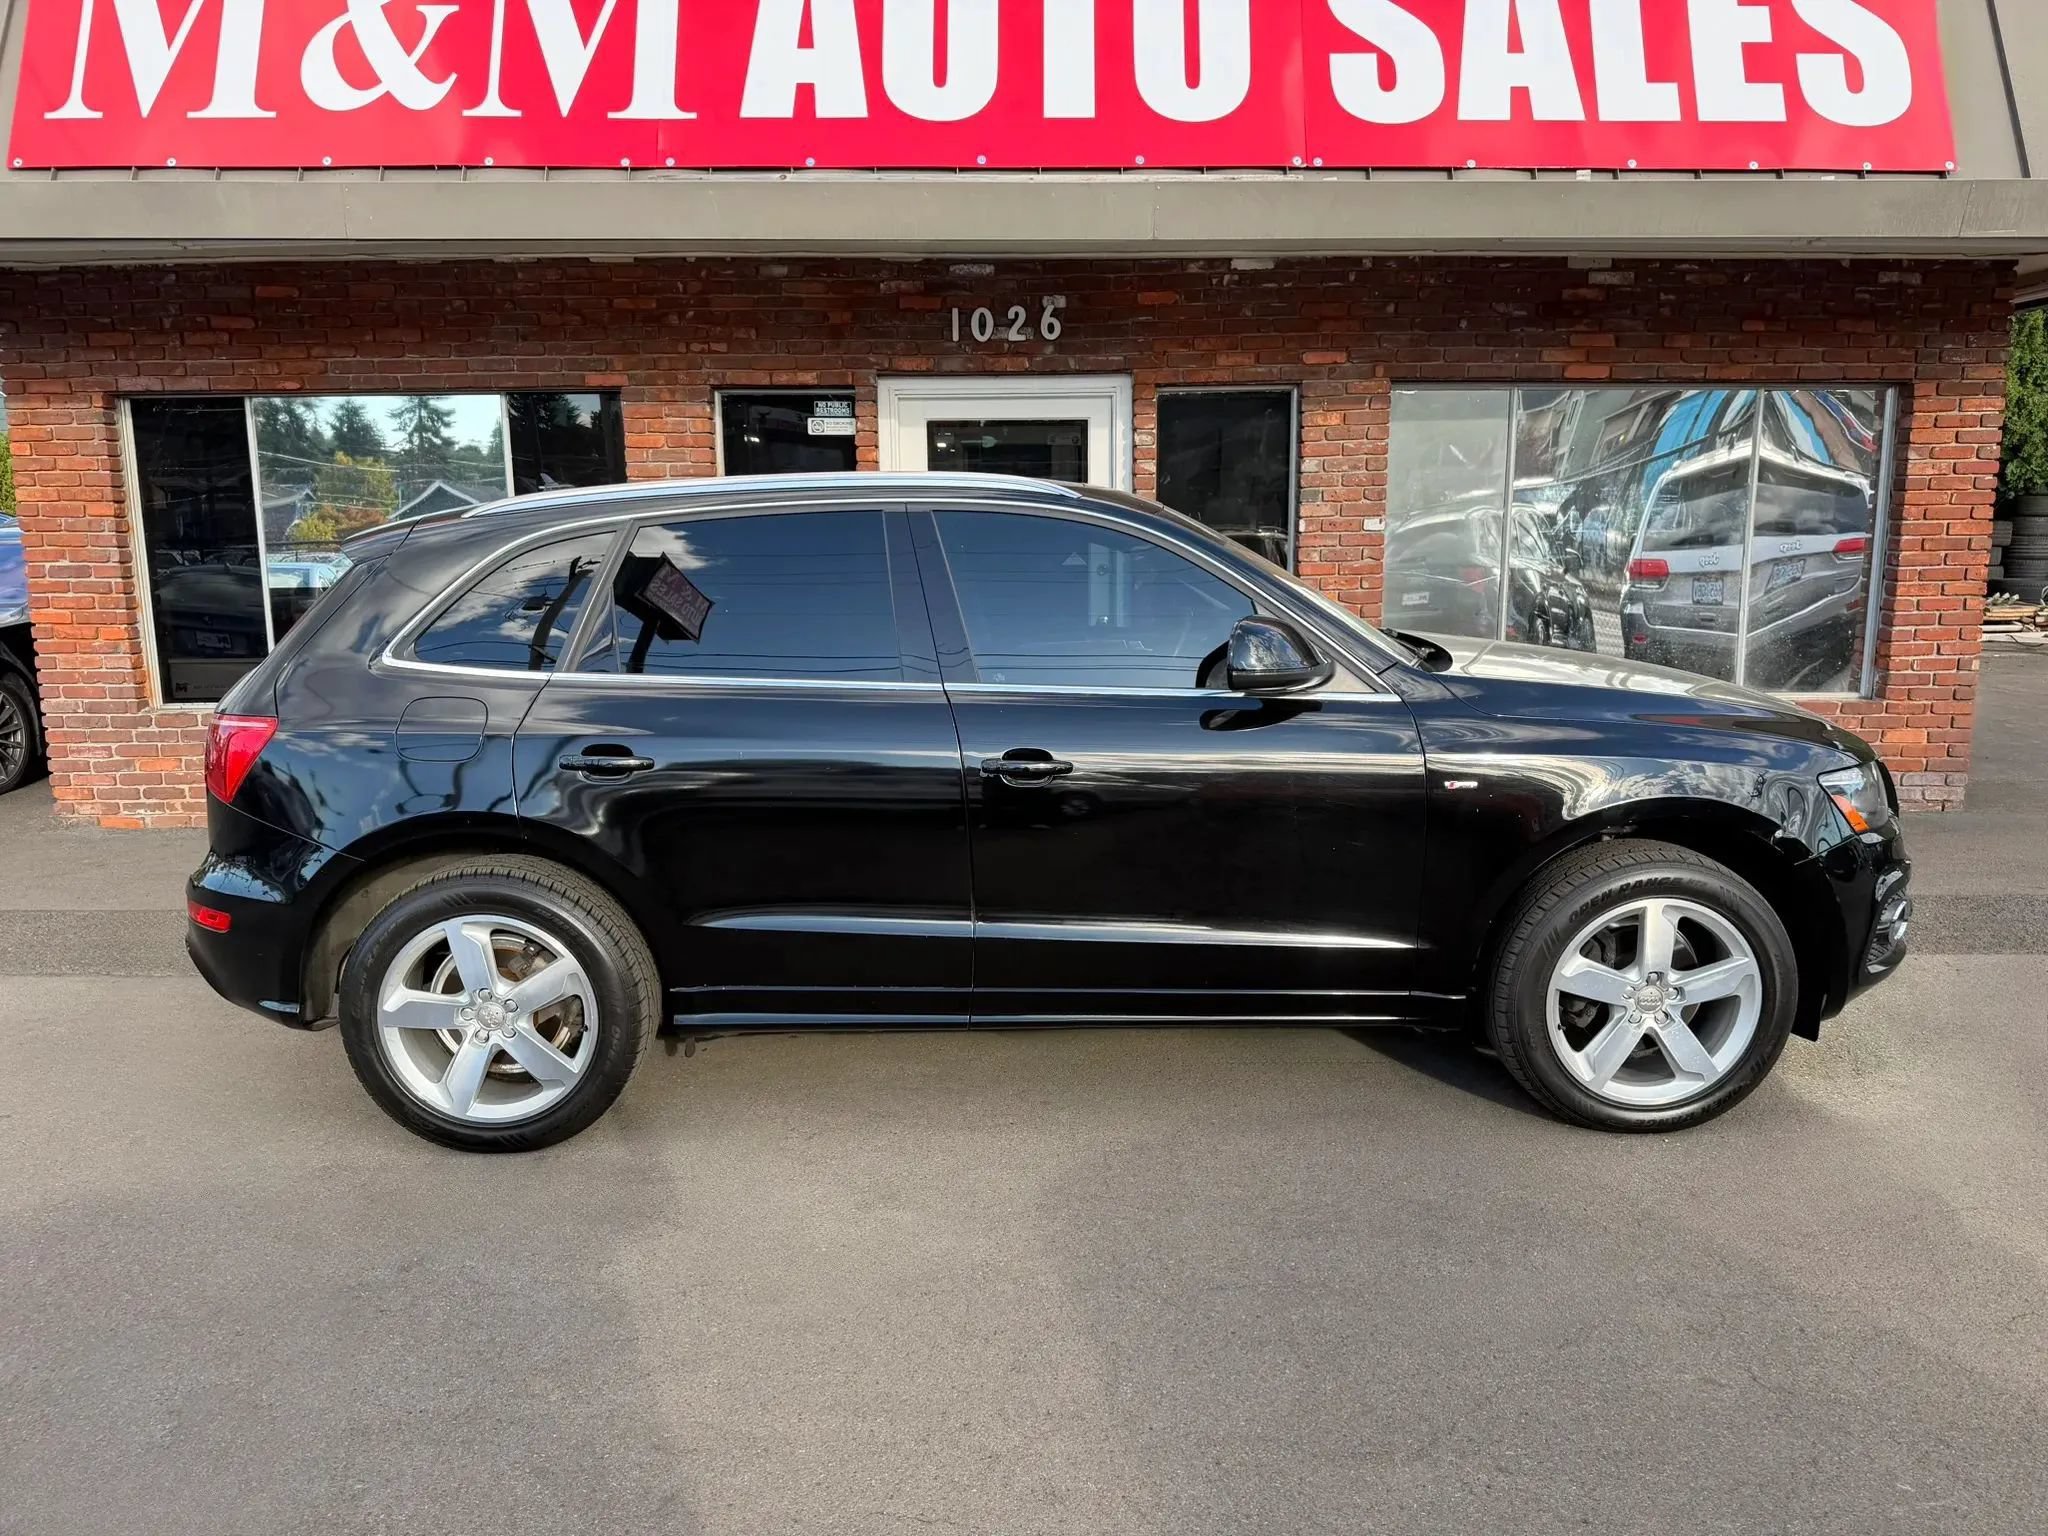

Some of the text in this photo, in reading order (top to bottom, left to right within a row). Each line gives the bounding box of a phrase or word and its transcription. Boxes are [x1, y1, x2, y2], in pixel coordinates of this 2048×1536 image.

[1327, 0, 1912, 127] SALES
[952, 304, 1062, 342] 1026
[1569, 876, 1684, 924] OPEN RANGE
